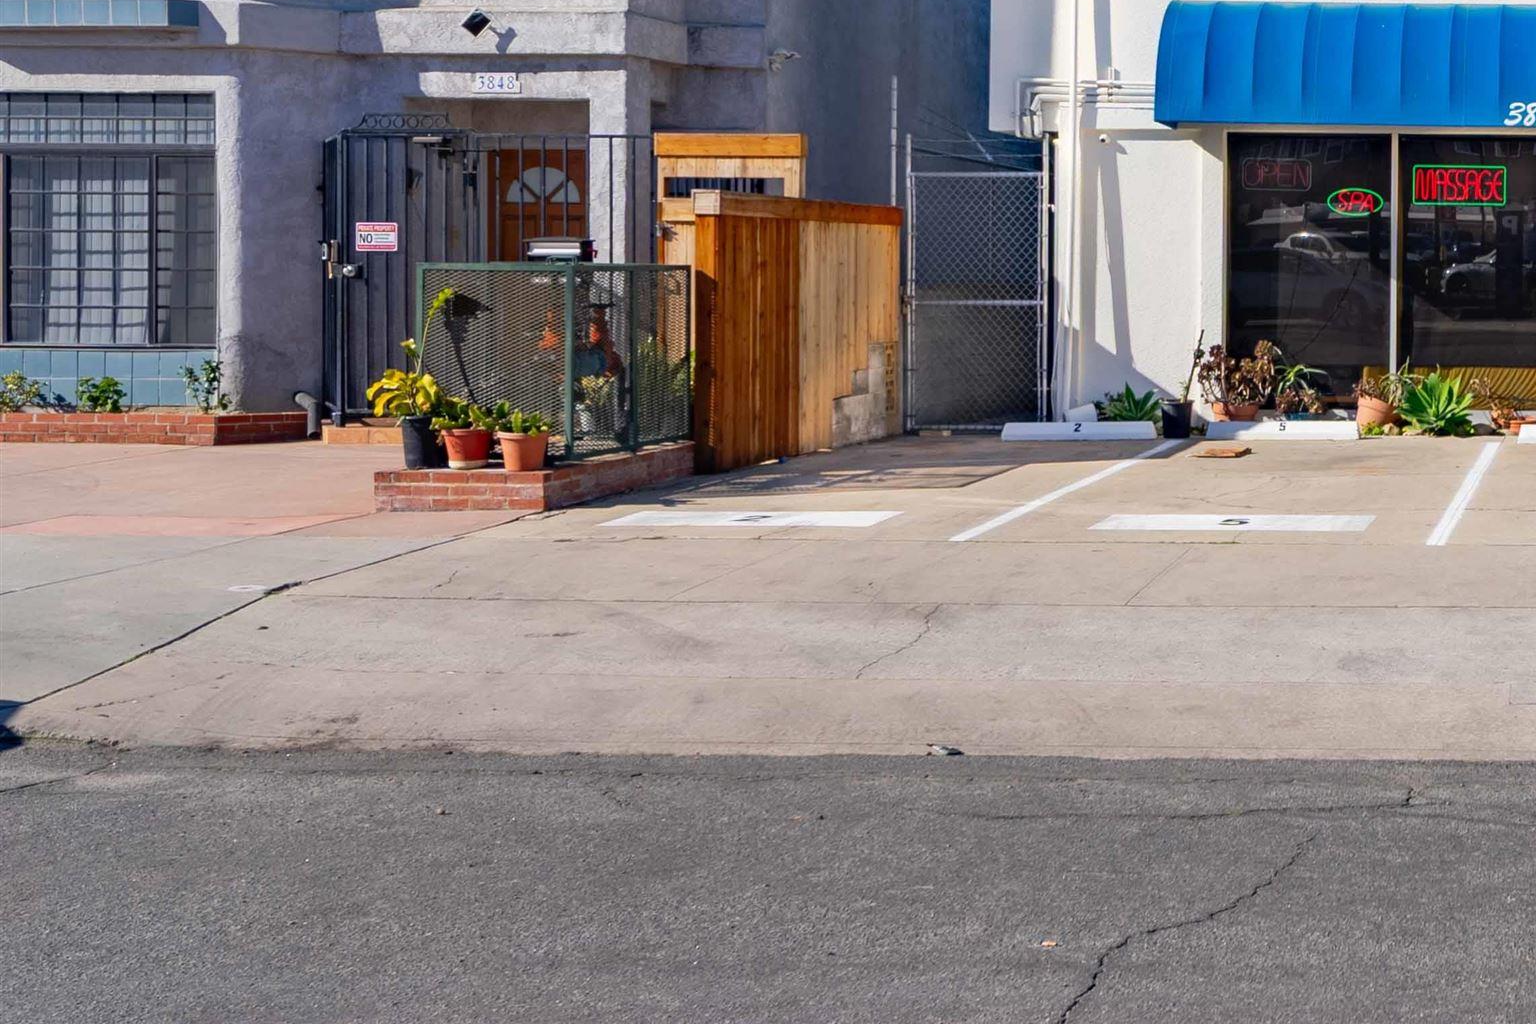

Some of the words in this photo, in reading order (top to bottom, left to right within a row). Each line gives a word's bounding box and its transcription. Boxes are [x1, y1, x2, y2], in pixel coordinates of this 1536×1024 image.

[478, 75, 515, 90] 3848
[1415, 168, 1503, 202] MASSAGE
[1337, 191, 1375, 213] SPA
[360, 233, 373, 244] NO
[1074, 422, 1082, 433] 2
[1279, 422, 1287, 432] 5
